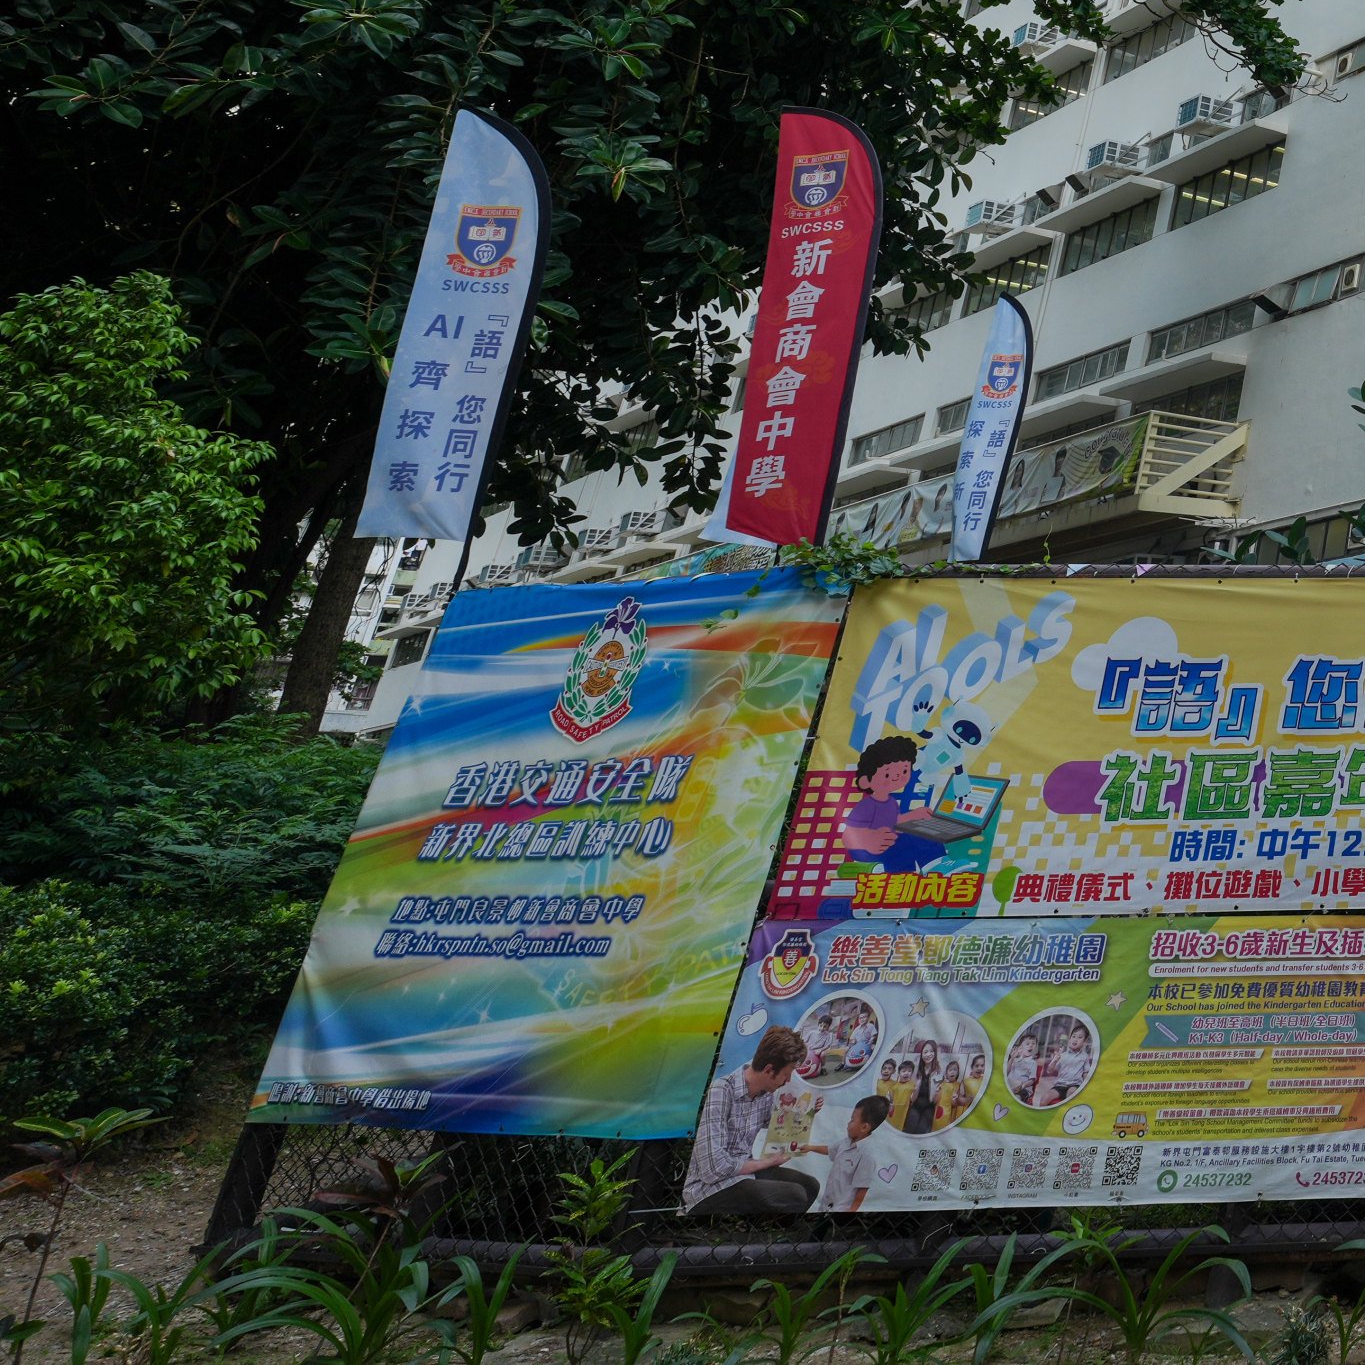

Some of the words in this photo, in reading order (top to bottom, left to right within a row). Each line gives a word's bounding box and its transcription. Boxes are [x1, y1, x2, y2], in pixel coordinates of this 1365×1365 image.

[781, 220, 844, 239] SWCSSS
[441, 279, 510, 295] SWCSSS
[745, 237, 833, 499] 新會商會中學
[977, 400, 1012, 409] SWCSSS
[555, 709, 569, 727] ROAD
[569, 721, 600, 739] SAFETY
[601, 706, 628, 726] PATROL
[442, 754, 694, 809] 香港交通安全隊
[417, 817, 672, 862] 新界北總區訓練中心
[1170, 829, 1244, 863] 時間:
[852, 872, 981, 907] 活動內容
[827, 934, 1105, 967] 樂善堂鄧德濂幼稚園
[822, 969, 850, 983] Lok
[852, 969, 876, 982] Sin
[878, 968, 915, 985] Tong
[917, 968, 949, 985] Tang
[954, 968, 979, 982] Tak
[983, 968, 1008, 982] Lim
[1009, 967, 1099, 984] Kindergarten
[1154, 963, 1195, 974] Enrolment
[1228, 963, 1264, 973] students
[1282, 962, 1314, 972] transfer
[1316, 962, 1350, 972] students
[1165, 1002, 1197, 1012] School
[1263, 999, 1322, 1012] Kindergarten
[1183, 1172, 1252, 1188] 24537232
